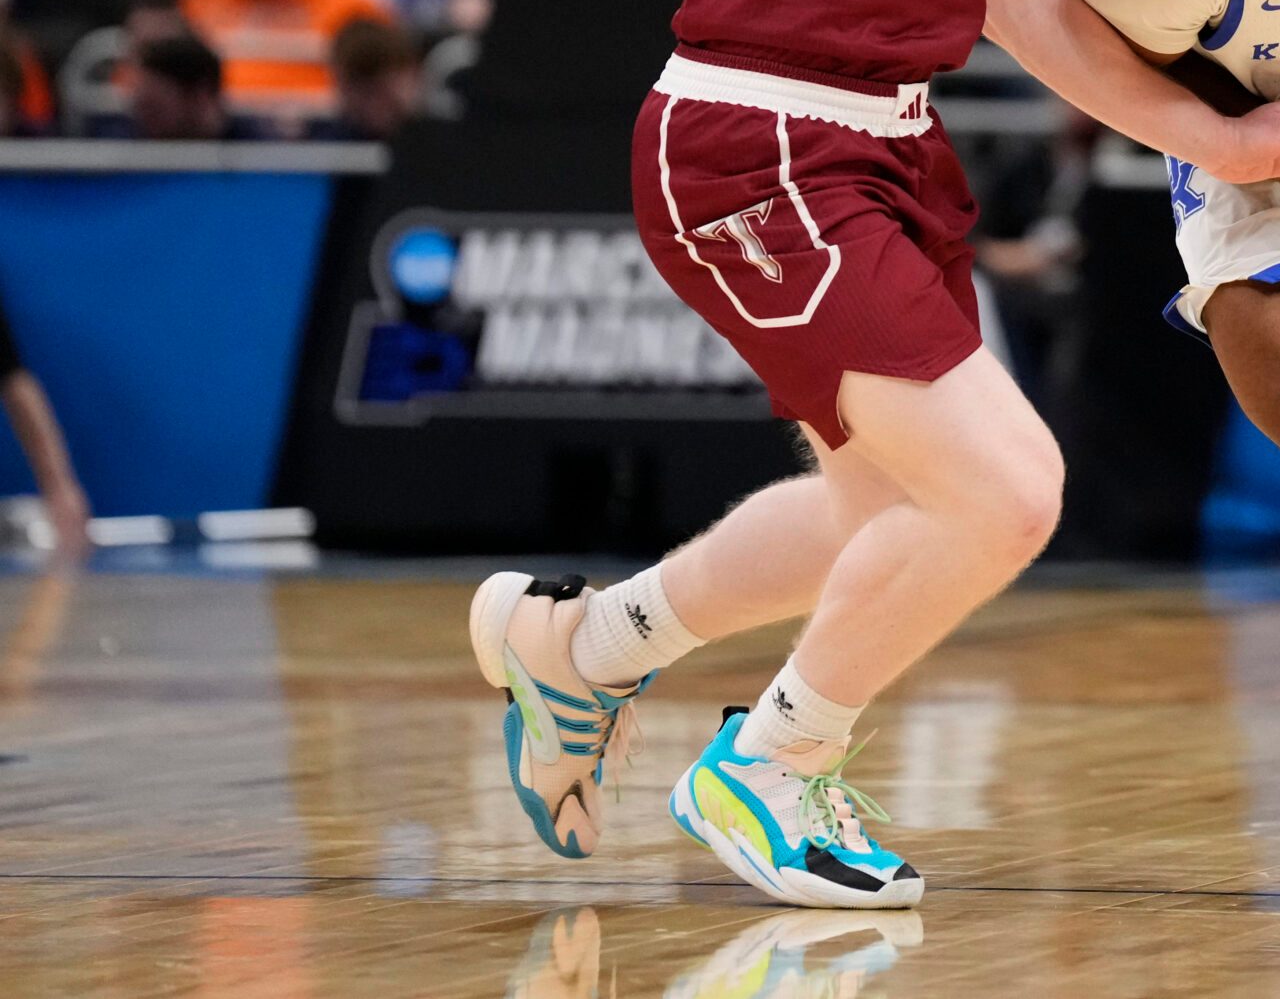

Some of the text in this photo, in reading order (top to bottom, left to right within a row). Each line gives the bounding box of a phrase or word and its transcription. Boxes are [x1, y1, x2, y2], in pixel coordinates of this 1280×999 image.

[455, 229, 680, 299] MARC
[692, 197, 783, 284] T
[478, 307, 757, 382] MADNES
